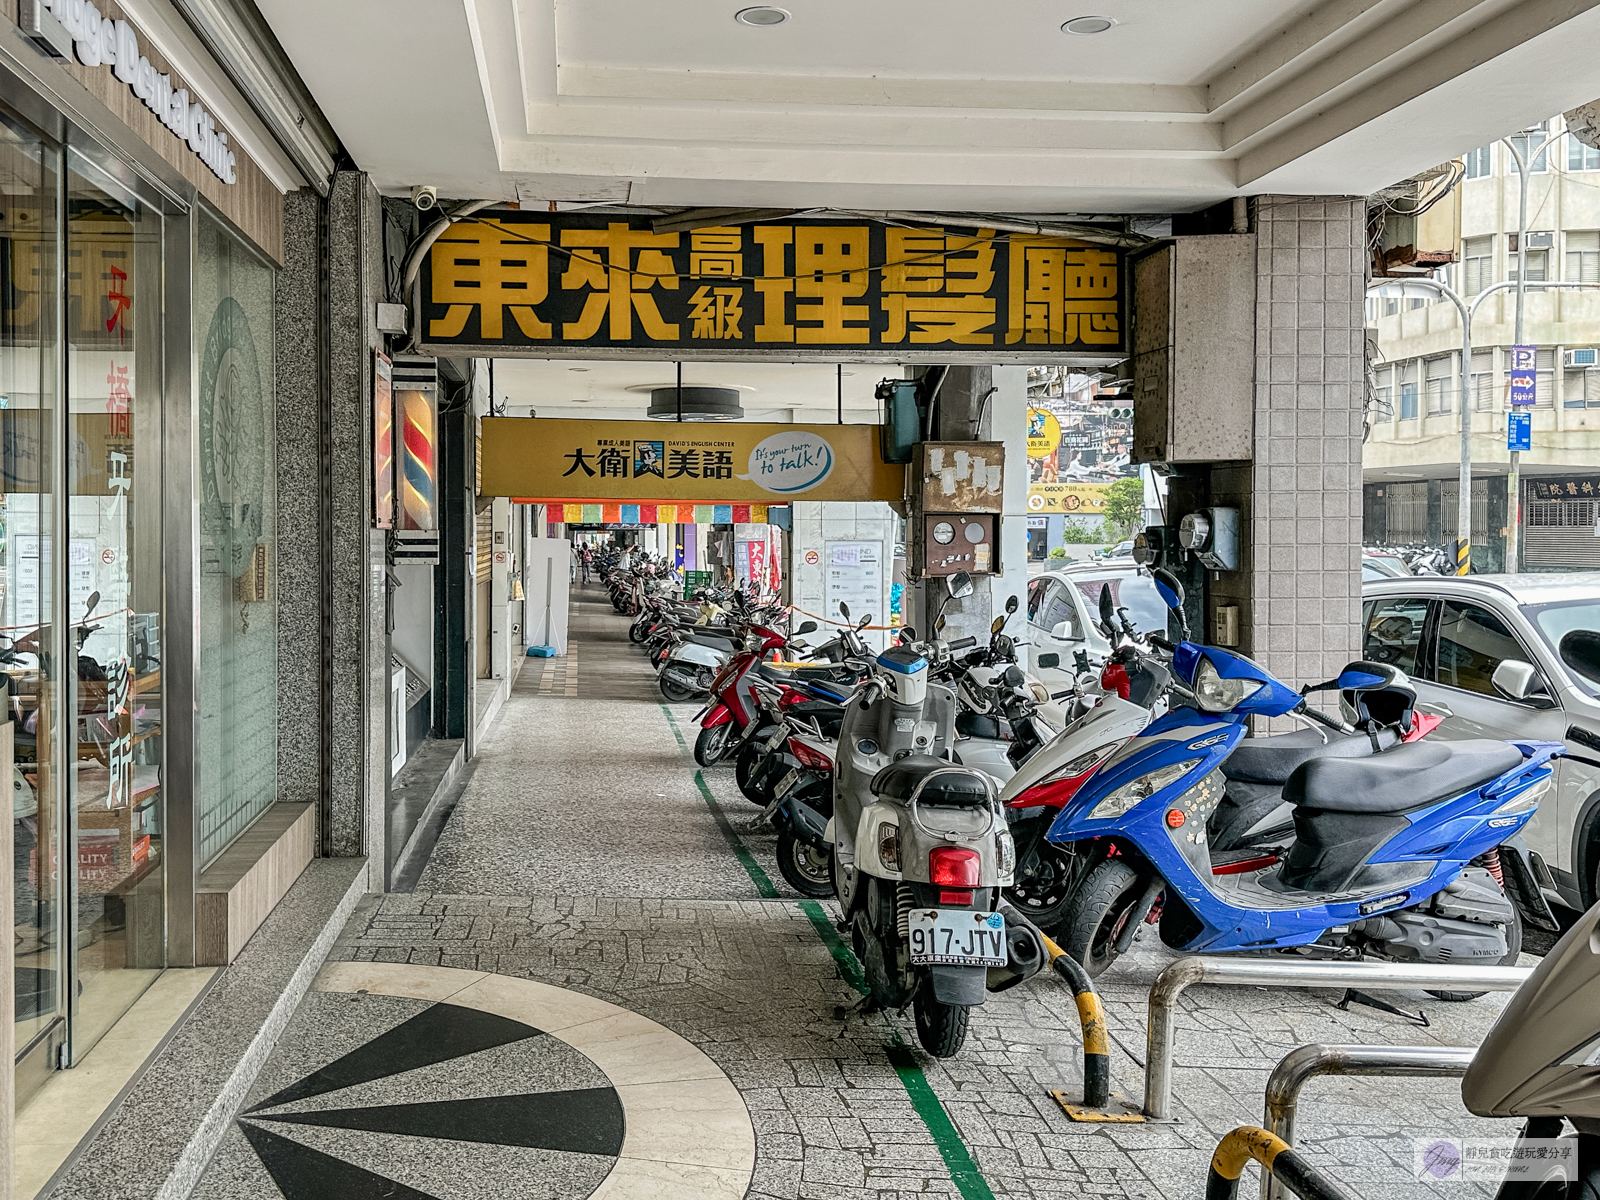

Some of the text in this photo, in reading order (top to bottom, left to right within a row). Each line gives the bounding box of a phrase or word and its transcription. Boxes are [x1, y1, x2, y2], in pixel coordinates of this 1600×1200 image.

[114, 19, 189, 139] Dental
[188, 102, 236, 185] Clinic
[597, 439, 631, 447] 專業成人美語
[755, 443, 812, 462] It's your turn
[761, 446, 823, 475] to talk!
